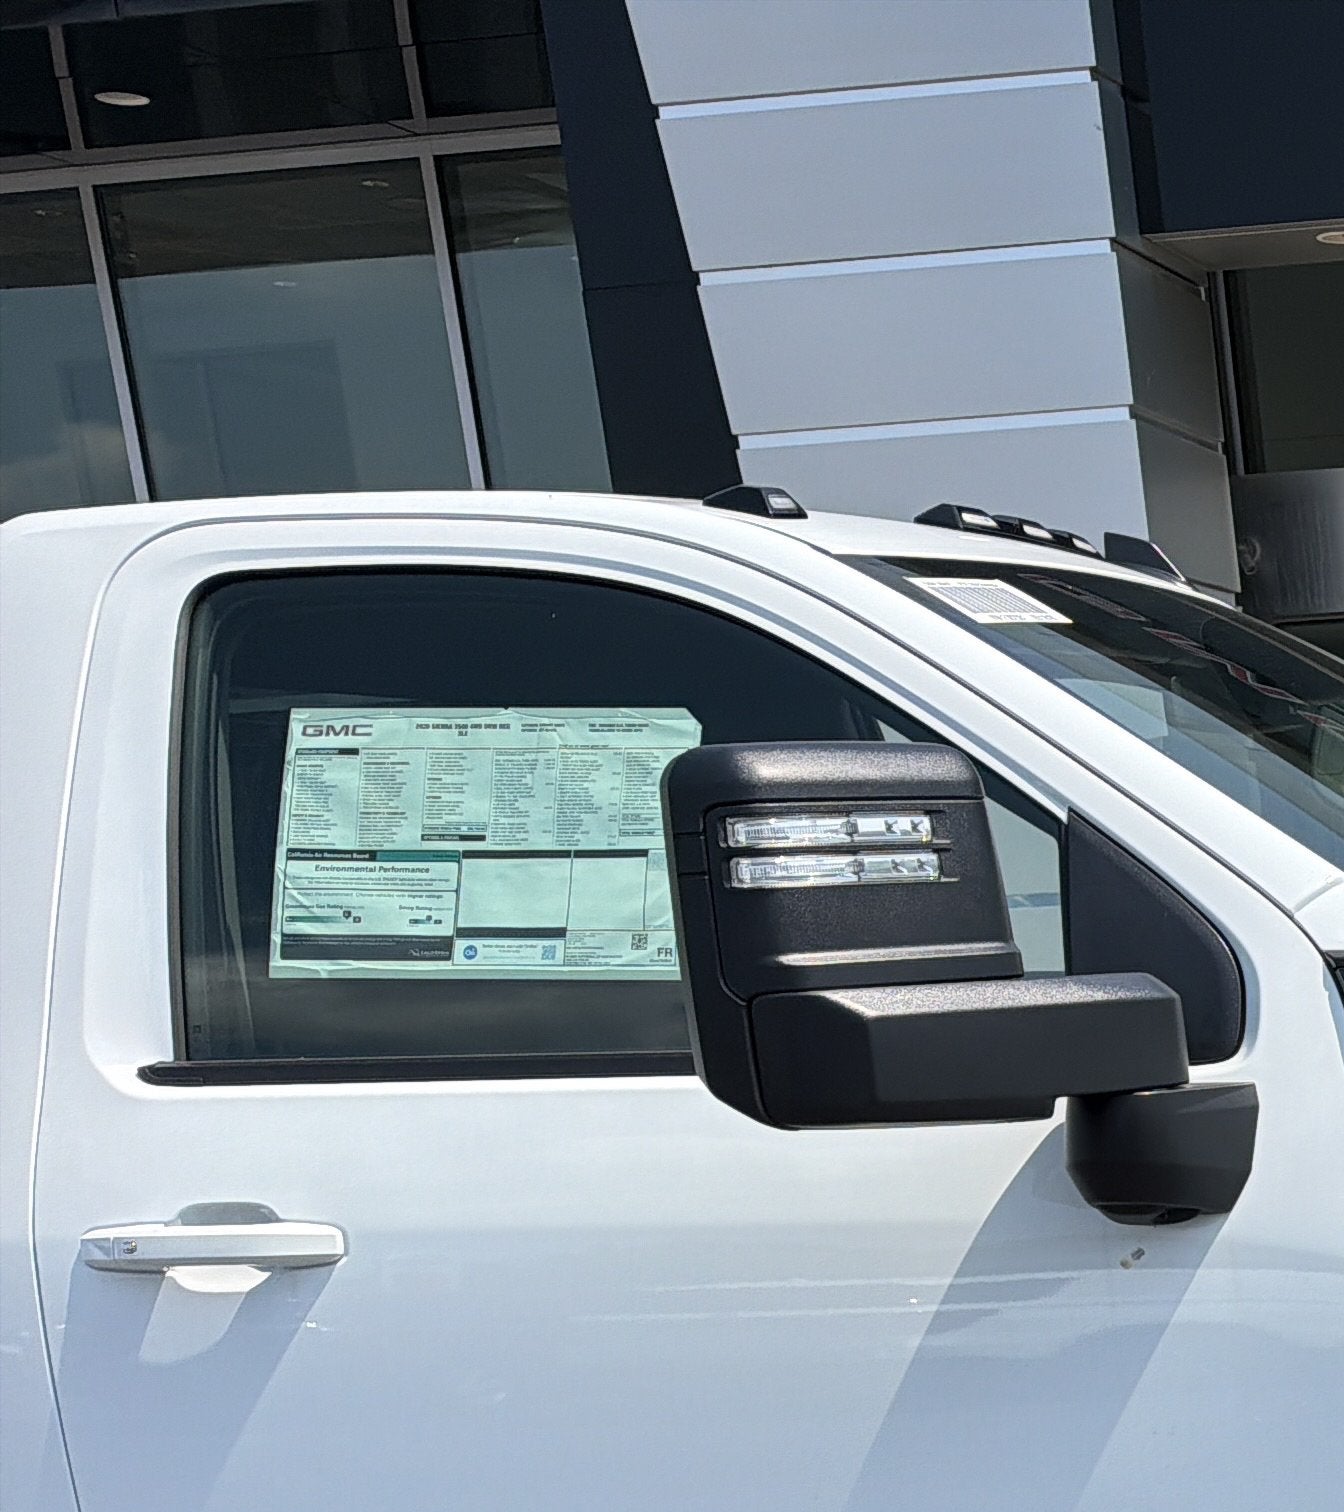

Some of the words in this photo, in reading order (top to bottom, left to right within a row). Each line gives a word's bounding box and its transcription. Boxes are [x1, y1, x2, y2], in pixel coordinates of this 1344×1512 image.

[301, 723, 373, 737] GMC
[314, 864, 377, 873] Environmental
[378, 865, 430, 874] Performance
[656, 947, 673, 957] FR
